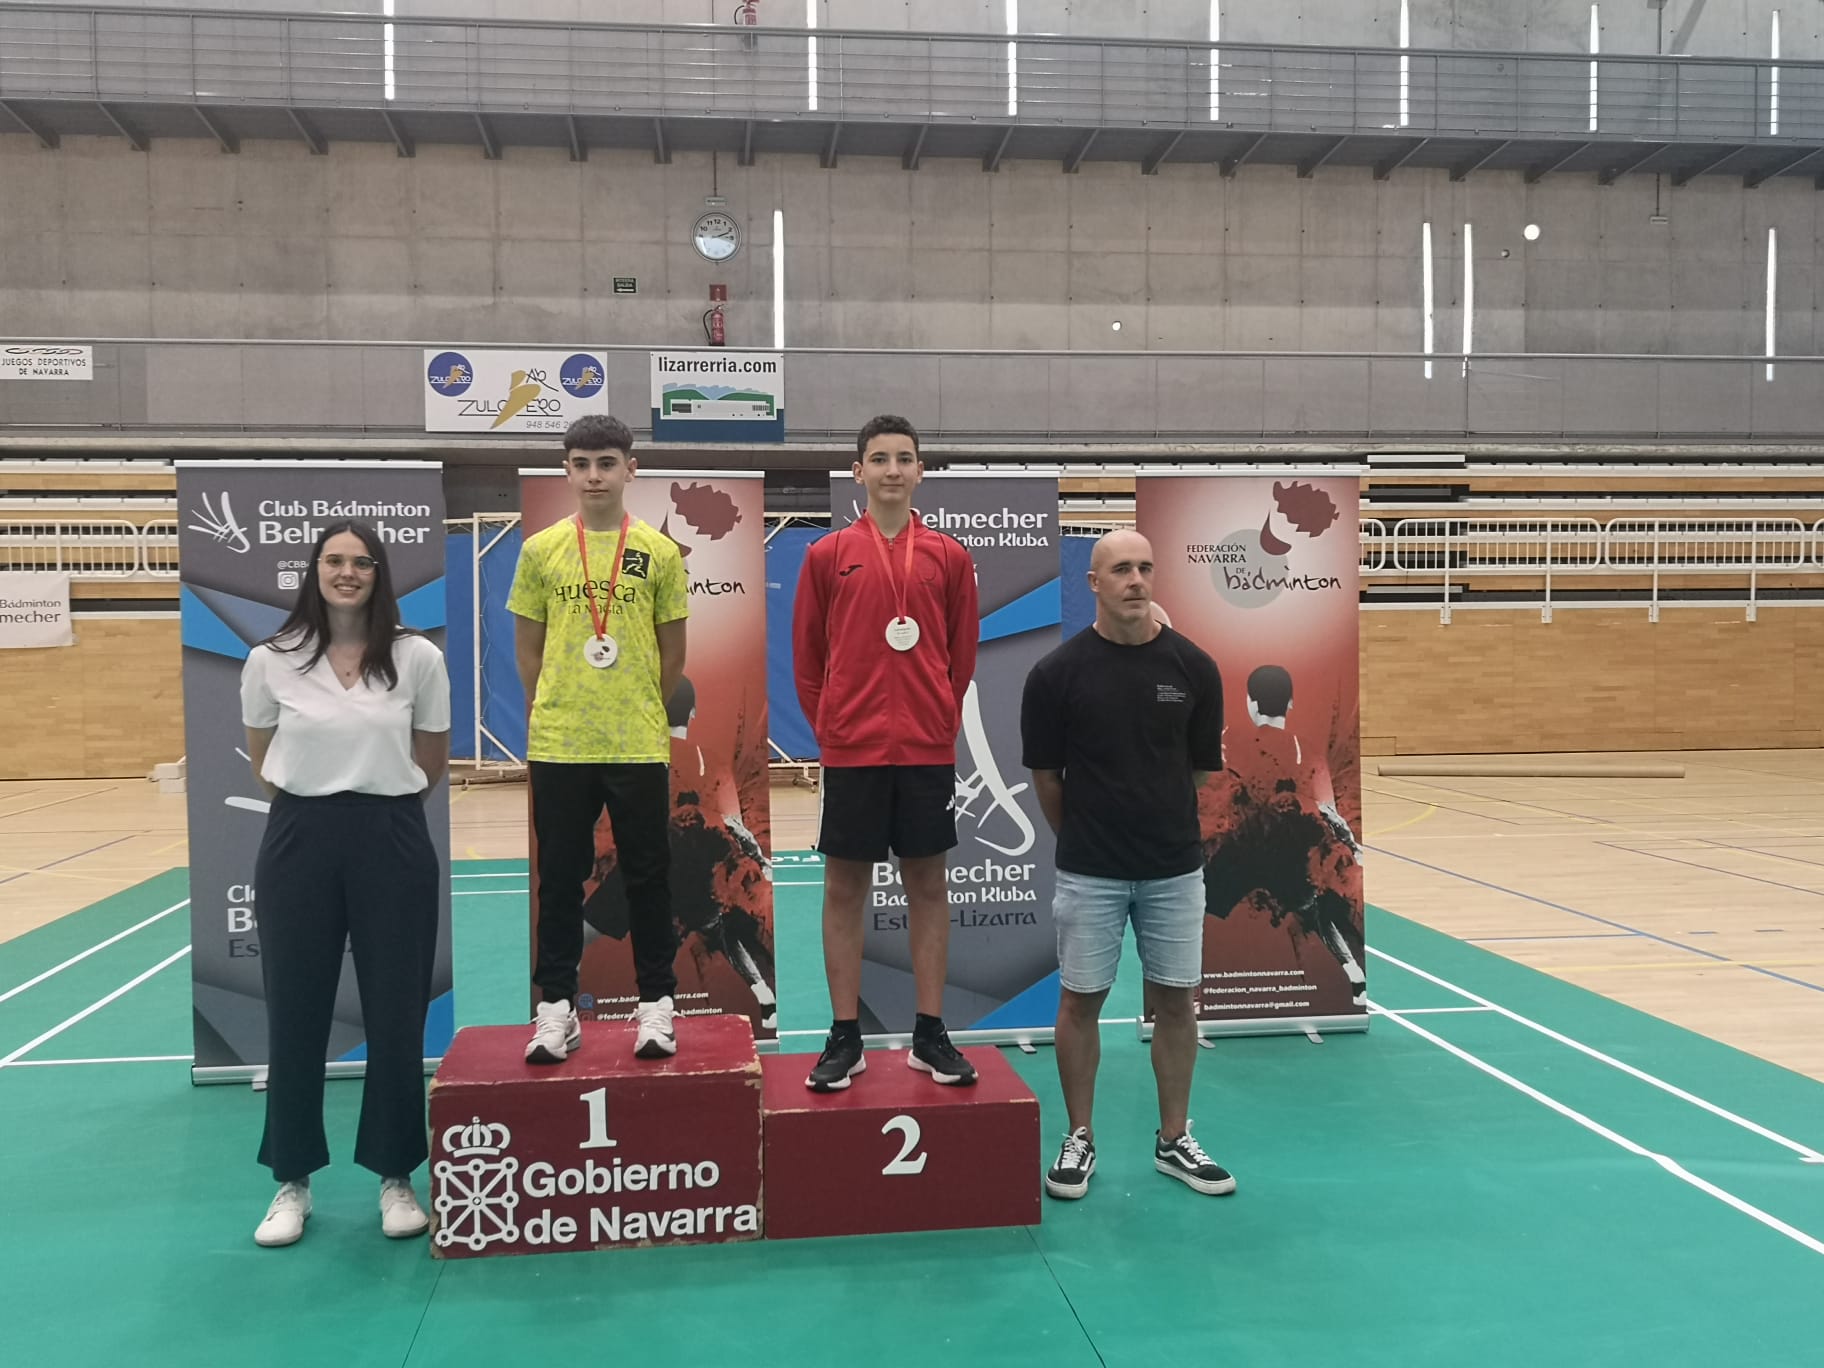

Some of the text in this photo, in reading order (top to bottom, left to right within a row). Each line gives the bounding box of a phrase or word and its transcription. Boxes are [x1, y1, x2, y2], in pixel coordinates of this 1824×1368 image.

[1, 358, 86, 367] JUEGOS DEPORTIVOS
[659, 357, 777, 373] lizarrerria.com
[526, 421, 542, 429] 948
[545, 421, 561, 429] 546
[259, 500, 431, 517] Club Bádminton
[910, 507, 1048, 529] elmecher
[259, 521, 431, 544] Belher
[999, 533, 1049, 547] Kluba
[1186, 543, 1246, 553] FEDERACIÓN
[1187, 553, 1246, 564] NAVARRA
[981, 886, 1037, 903] Kluba
[1203, 968, 1305, 979] www.badmintonnavarra.com
[1204, 1001, 1309, 1011] badmintonnavarra@gmail.com
[579, 1087, 617, 1149] 1
[881, 1115, 927, 1176] 2
[522, 1157, 720, 1198] Gobierno
[524, 1203, 758, 1245] de Navarra
